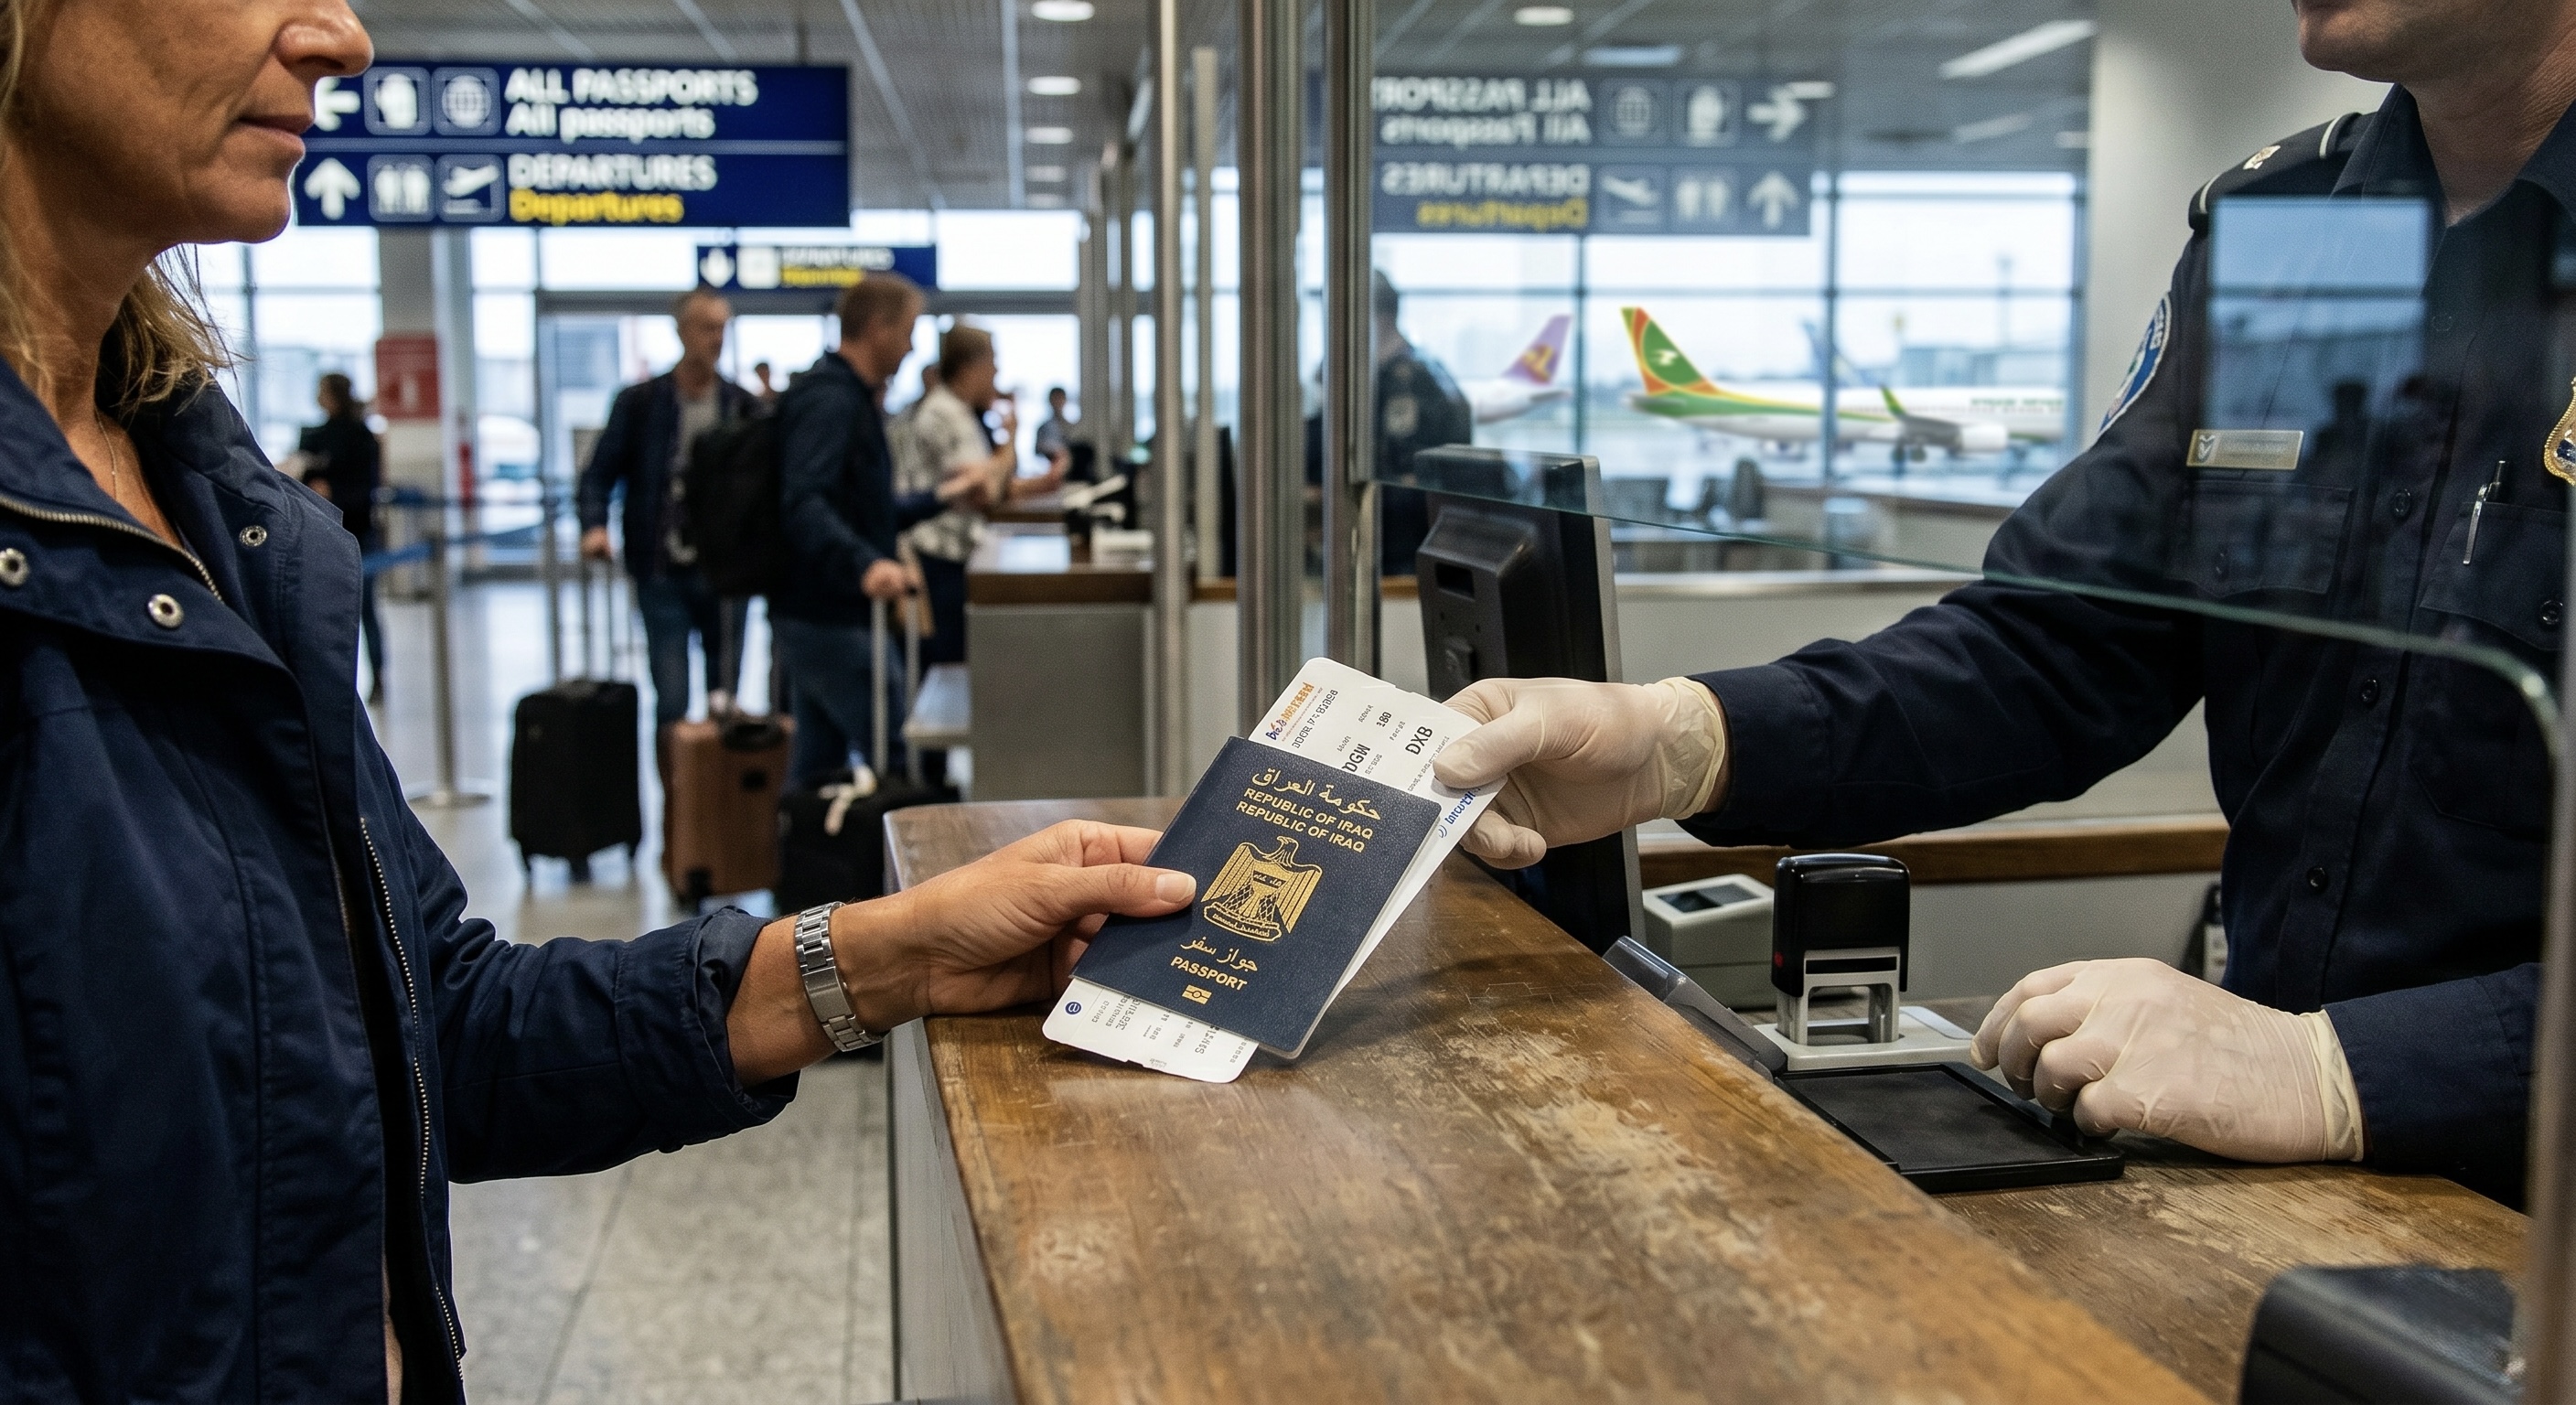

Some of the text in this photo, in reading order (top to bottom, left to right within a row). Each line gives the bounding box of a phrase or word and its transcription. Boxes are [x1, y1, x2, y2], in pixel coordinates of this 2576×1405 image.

[505, 68, 758, 106] ALL PASSPORTS
[505, 102, 715, 145] All passports
[508, 154, 717, 191] DEPARTURES
[510, 188, 684, 226] Departures
[1404, 725, 1433, 756] DXB
[1251, 767, 1381, 820] حكومة العراق
[1236, 800, 1365, 853] REPUBLIC OF IRAQ
[1243, 788, 1373, 840] REPUBLIC OF IRAQ
[1180, 936, 1258, 972] جواز سفر
[1170, 956, 1248, 991] PASSPORT
